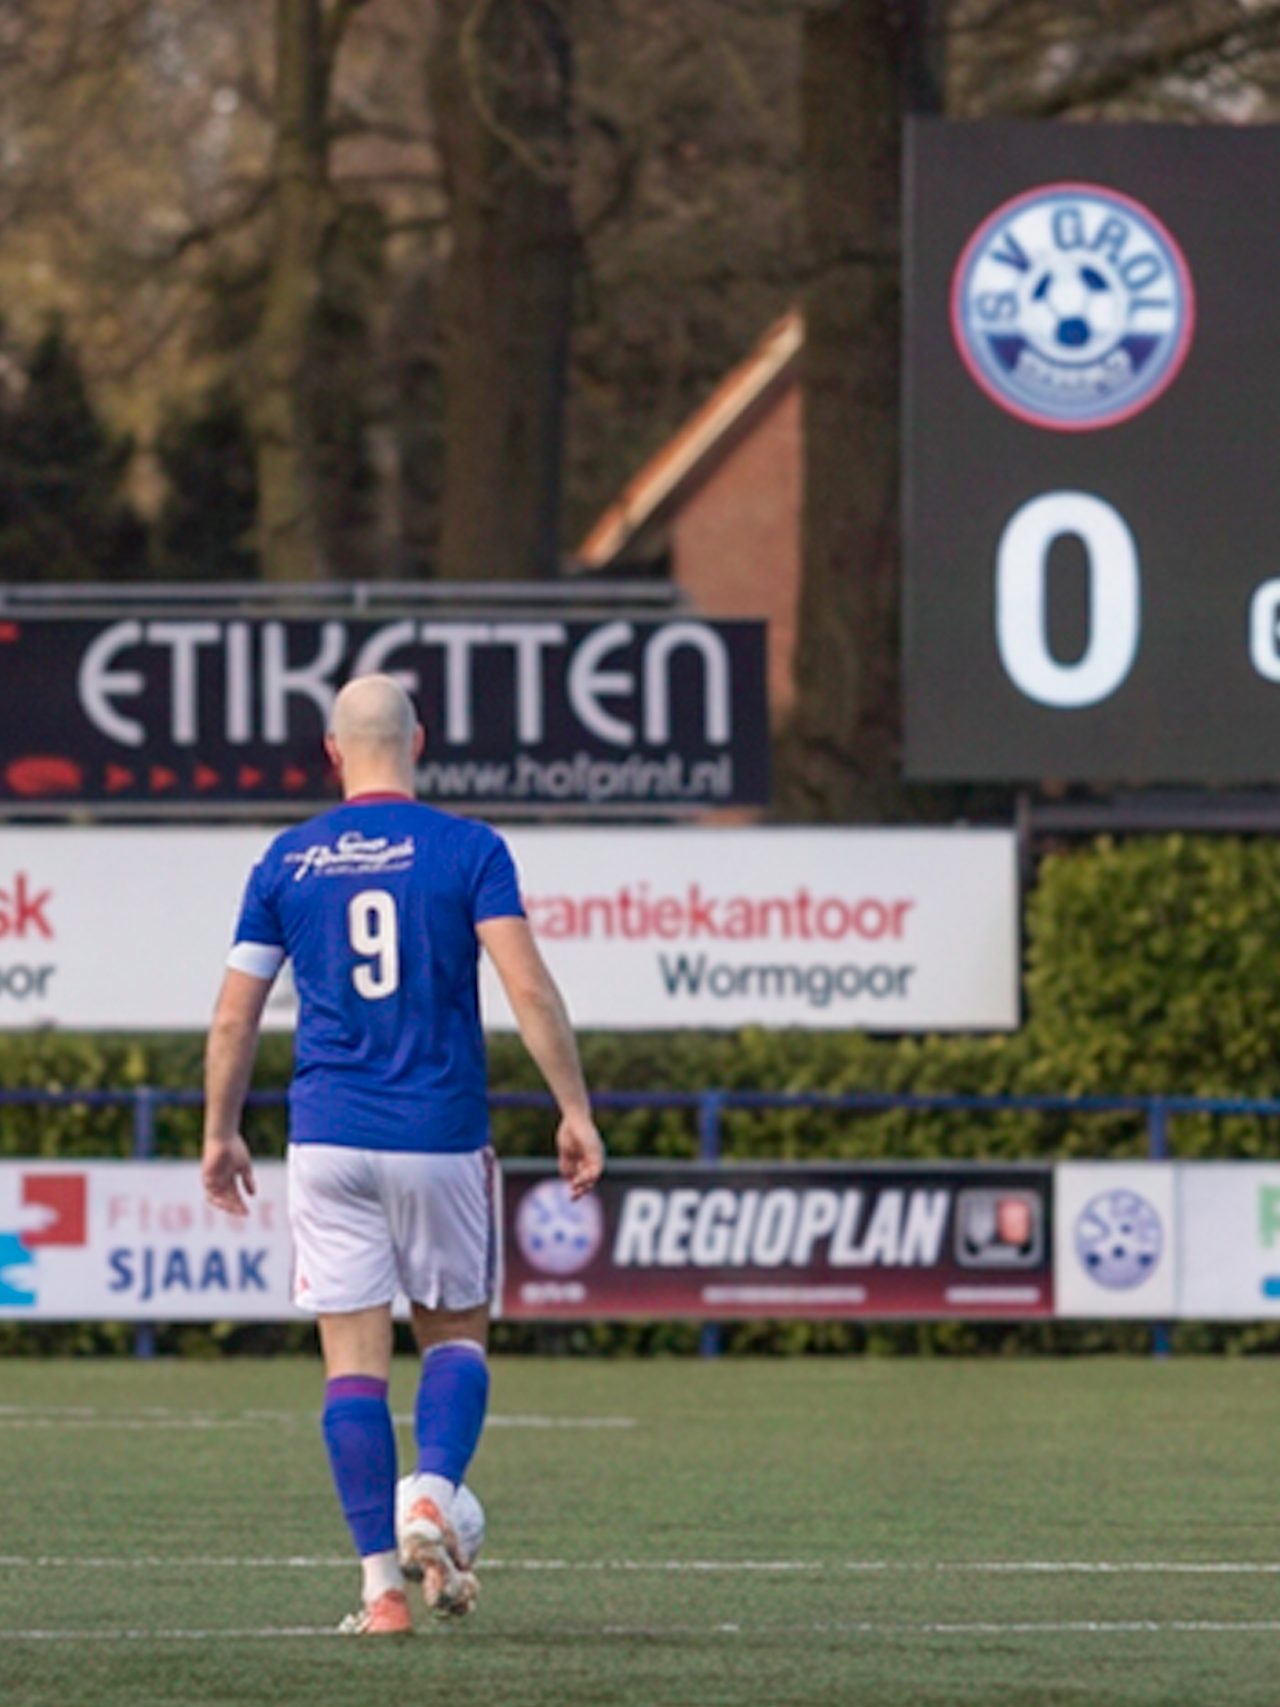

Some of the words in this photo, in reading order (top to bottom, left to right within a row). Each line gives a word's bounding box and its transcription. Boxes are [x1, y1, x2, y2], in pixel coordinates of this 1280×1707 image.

[995, 491, 1139, 707] 0
[350, 889, 398, 1000] 9
[658, 954, 914, 1008] Wormgoor
[614, 1188, 947, 1266] REGIOPLAN
[107, 1247, 268, 1301] SJAAK
